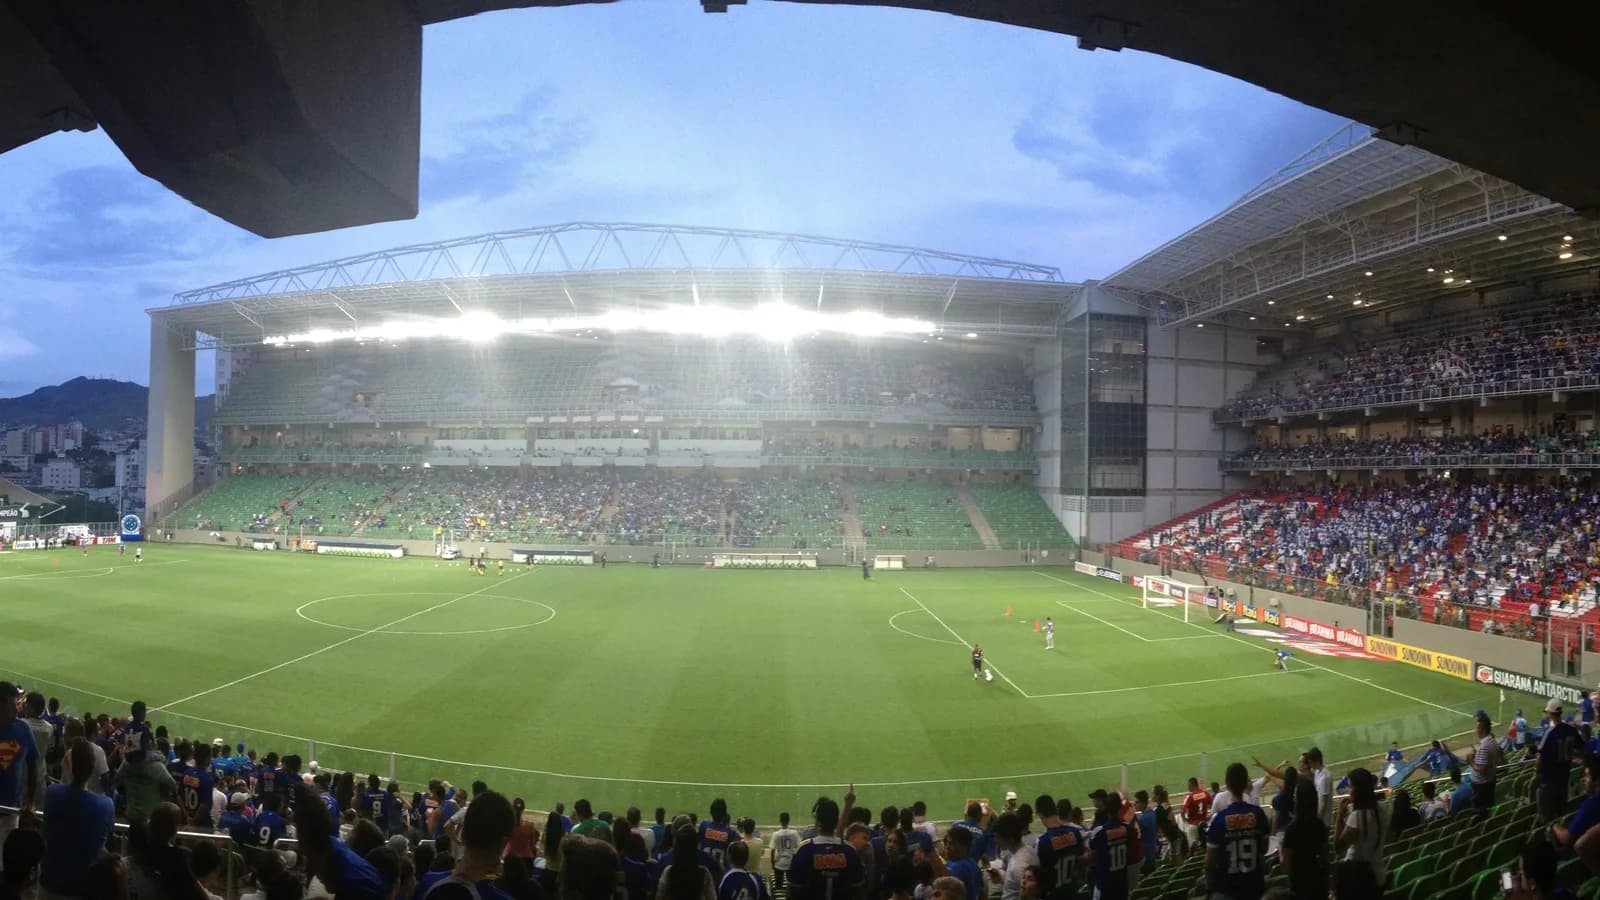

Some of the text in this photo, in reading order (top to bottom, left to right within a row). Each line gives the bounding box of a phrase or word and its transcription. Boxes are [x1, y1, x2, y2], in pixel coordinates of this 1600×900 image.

[1285, 617, 1364, 649] BRAHMA BRAHMA BRAHMA
[1370, 639, 1398, 658] SUNDOWN
[1401, 647, 1432, 668] SUNDOWN
[1436, 655, 1469, 678] SUNDOWN
[1494, 670, 1533, 693] GUARANÁ
[184, 787, 199, 810] 10
[372, 800, 382, 818] 9
[260, 826, 271, 845] 9
[780, 837, 792, 850] 10
[1109, 844, 1127, 872] 10
[1225, 839, 1257, 875] 19
